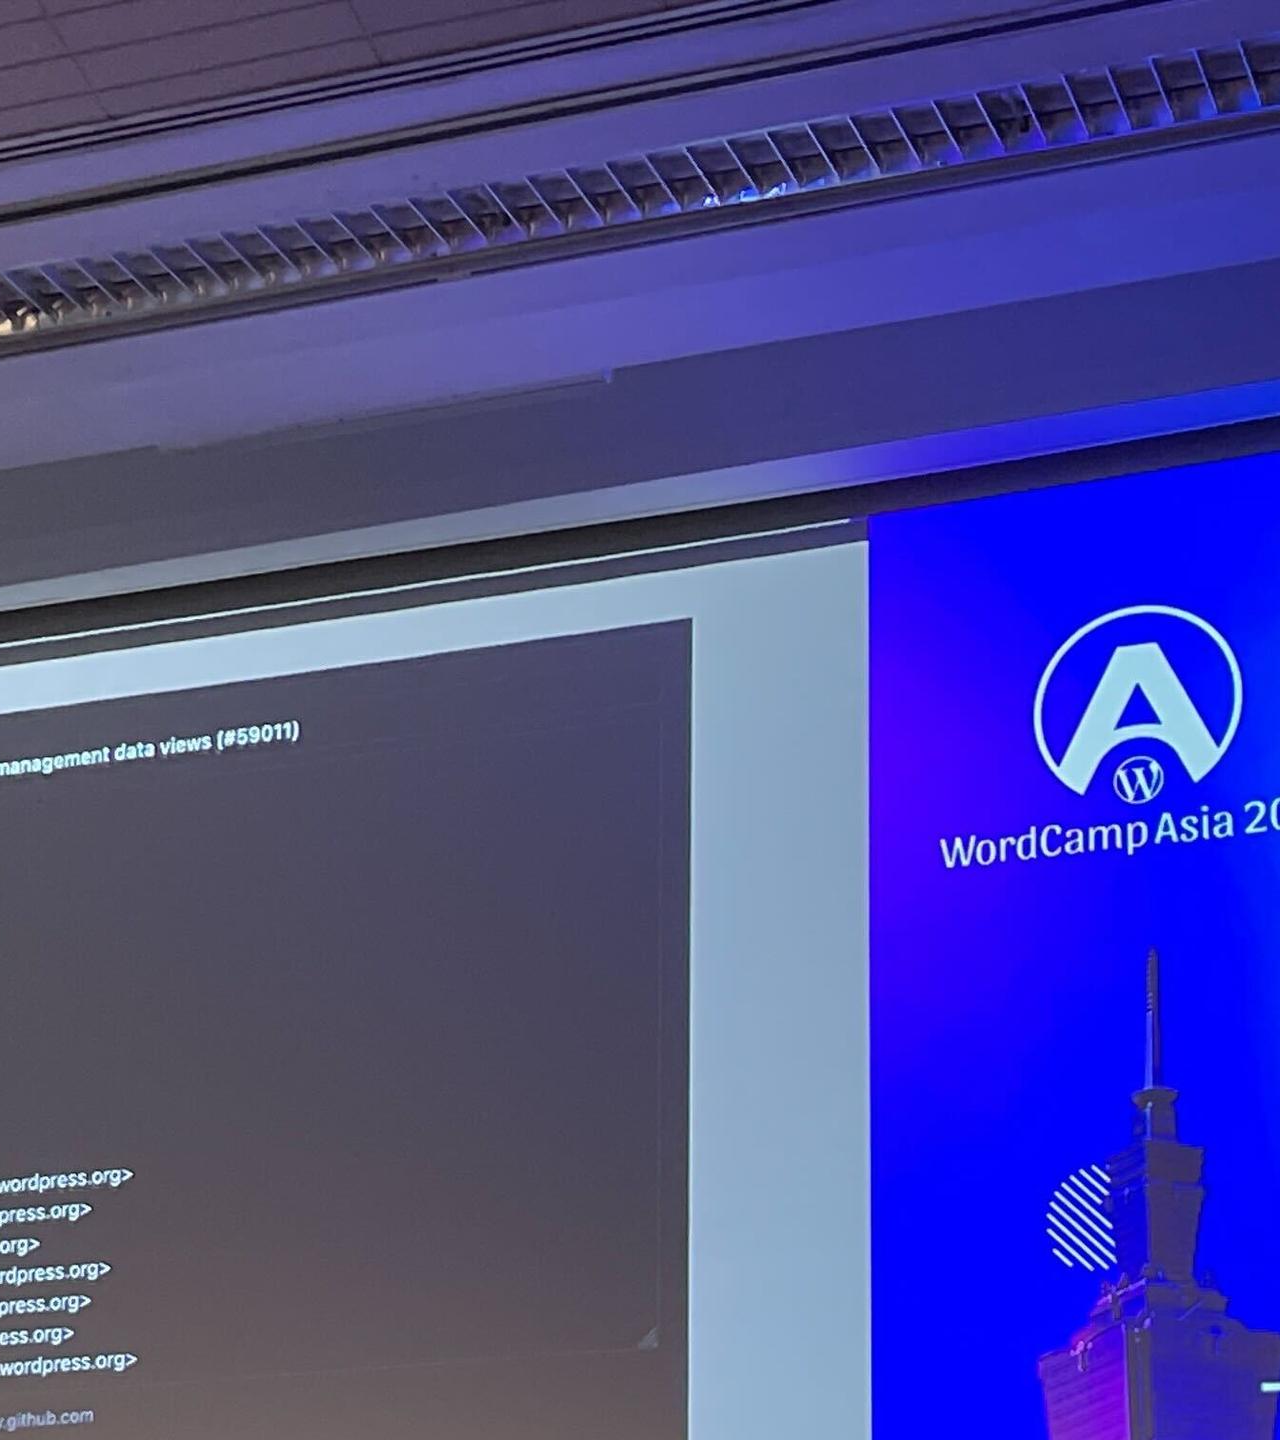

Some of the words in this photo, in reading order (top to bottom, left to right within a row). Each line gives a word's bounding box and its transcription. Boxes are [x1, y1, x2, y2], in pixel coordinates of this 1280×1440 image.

[114, 742, 155, 761] data
[159, 736, 212, 755] views
[217, 720, 299, 750] (#59011)
[939, 815, 1149, 869] WordCamp
[1154, 805, 1234, 845] Asia
